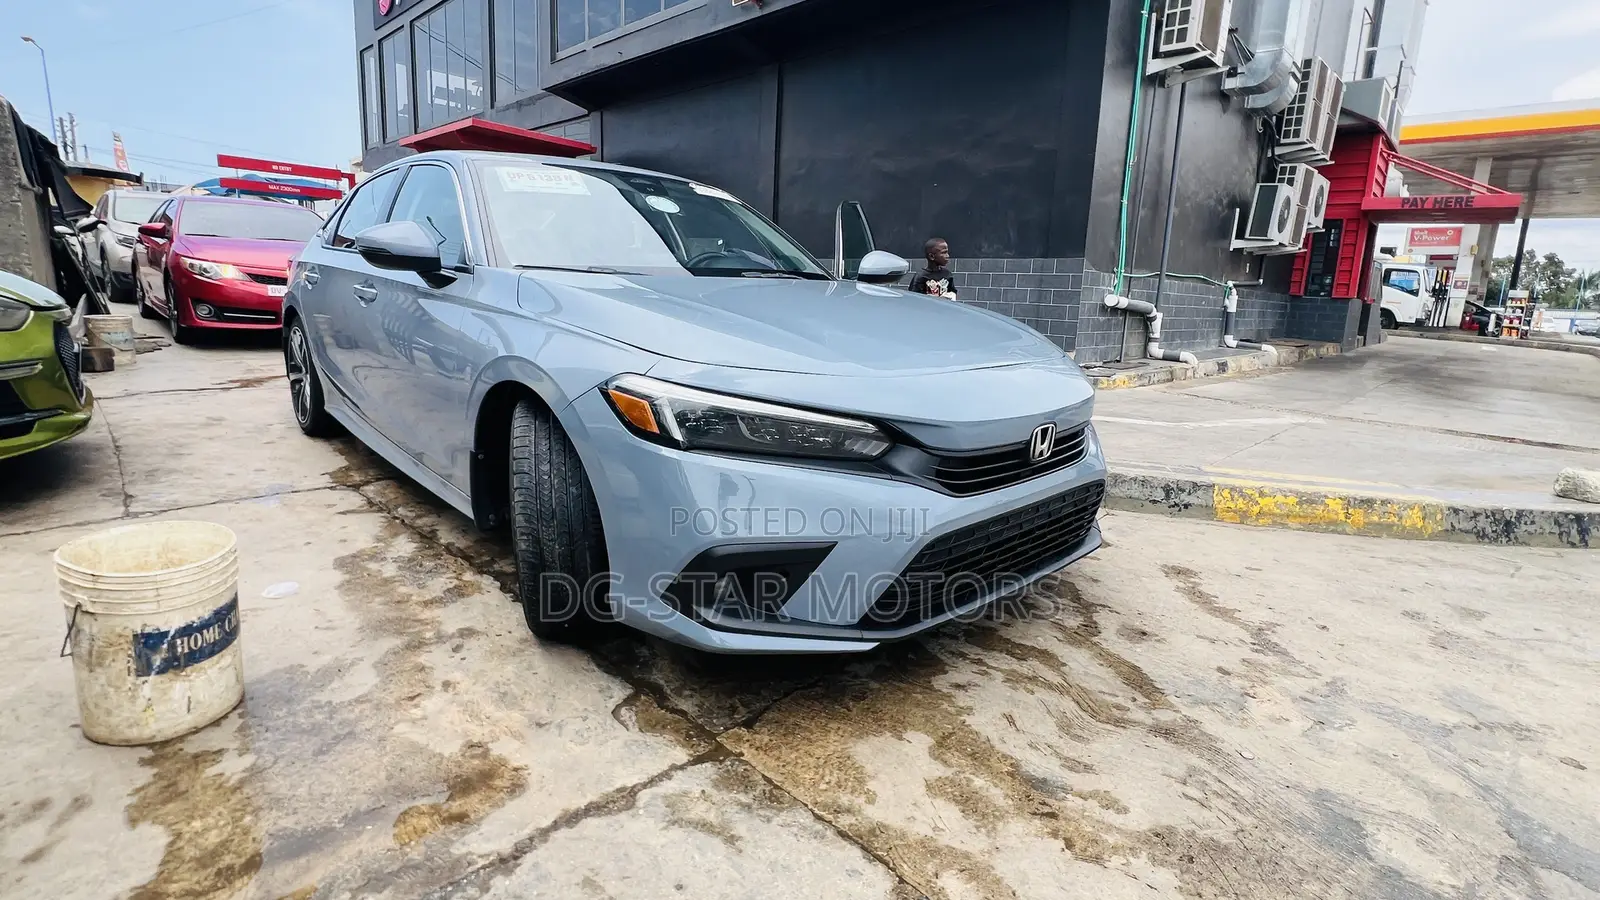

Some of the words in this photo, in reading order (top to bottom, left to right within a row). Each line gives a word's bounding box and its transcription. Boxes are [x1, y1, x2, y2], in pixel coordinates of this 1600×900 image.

[1401, 196, 1427, 208] PAY
[1432, 196, 1474, 208] HERE
[176, 622, 223, 656] HOME
